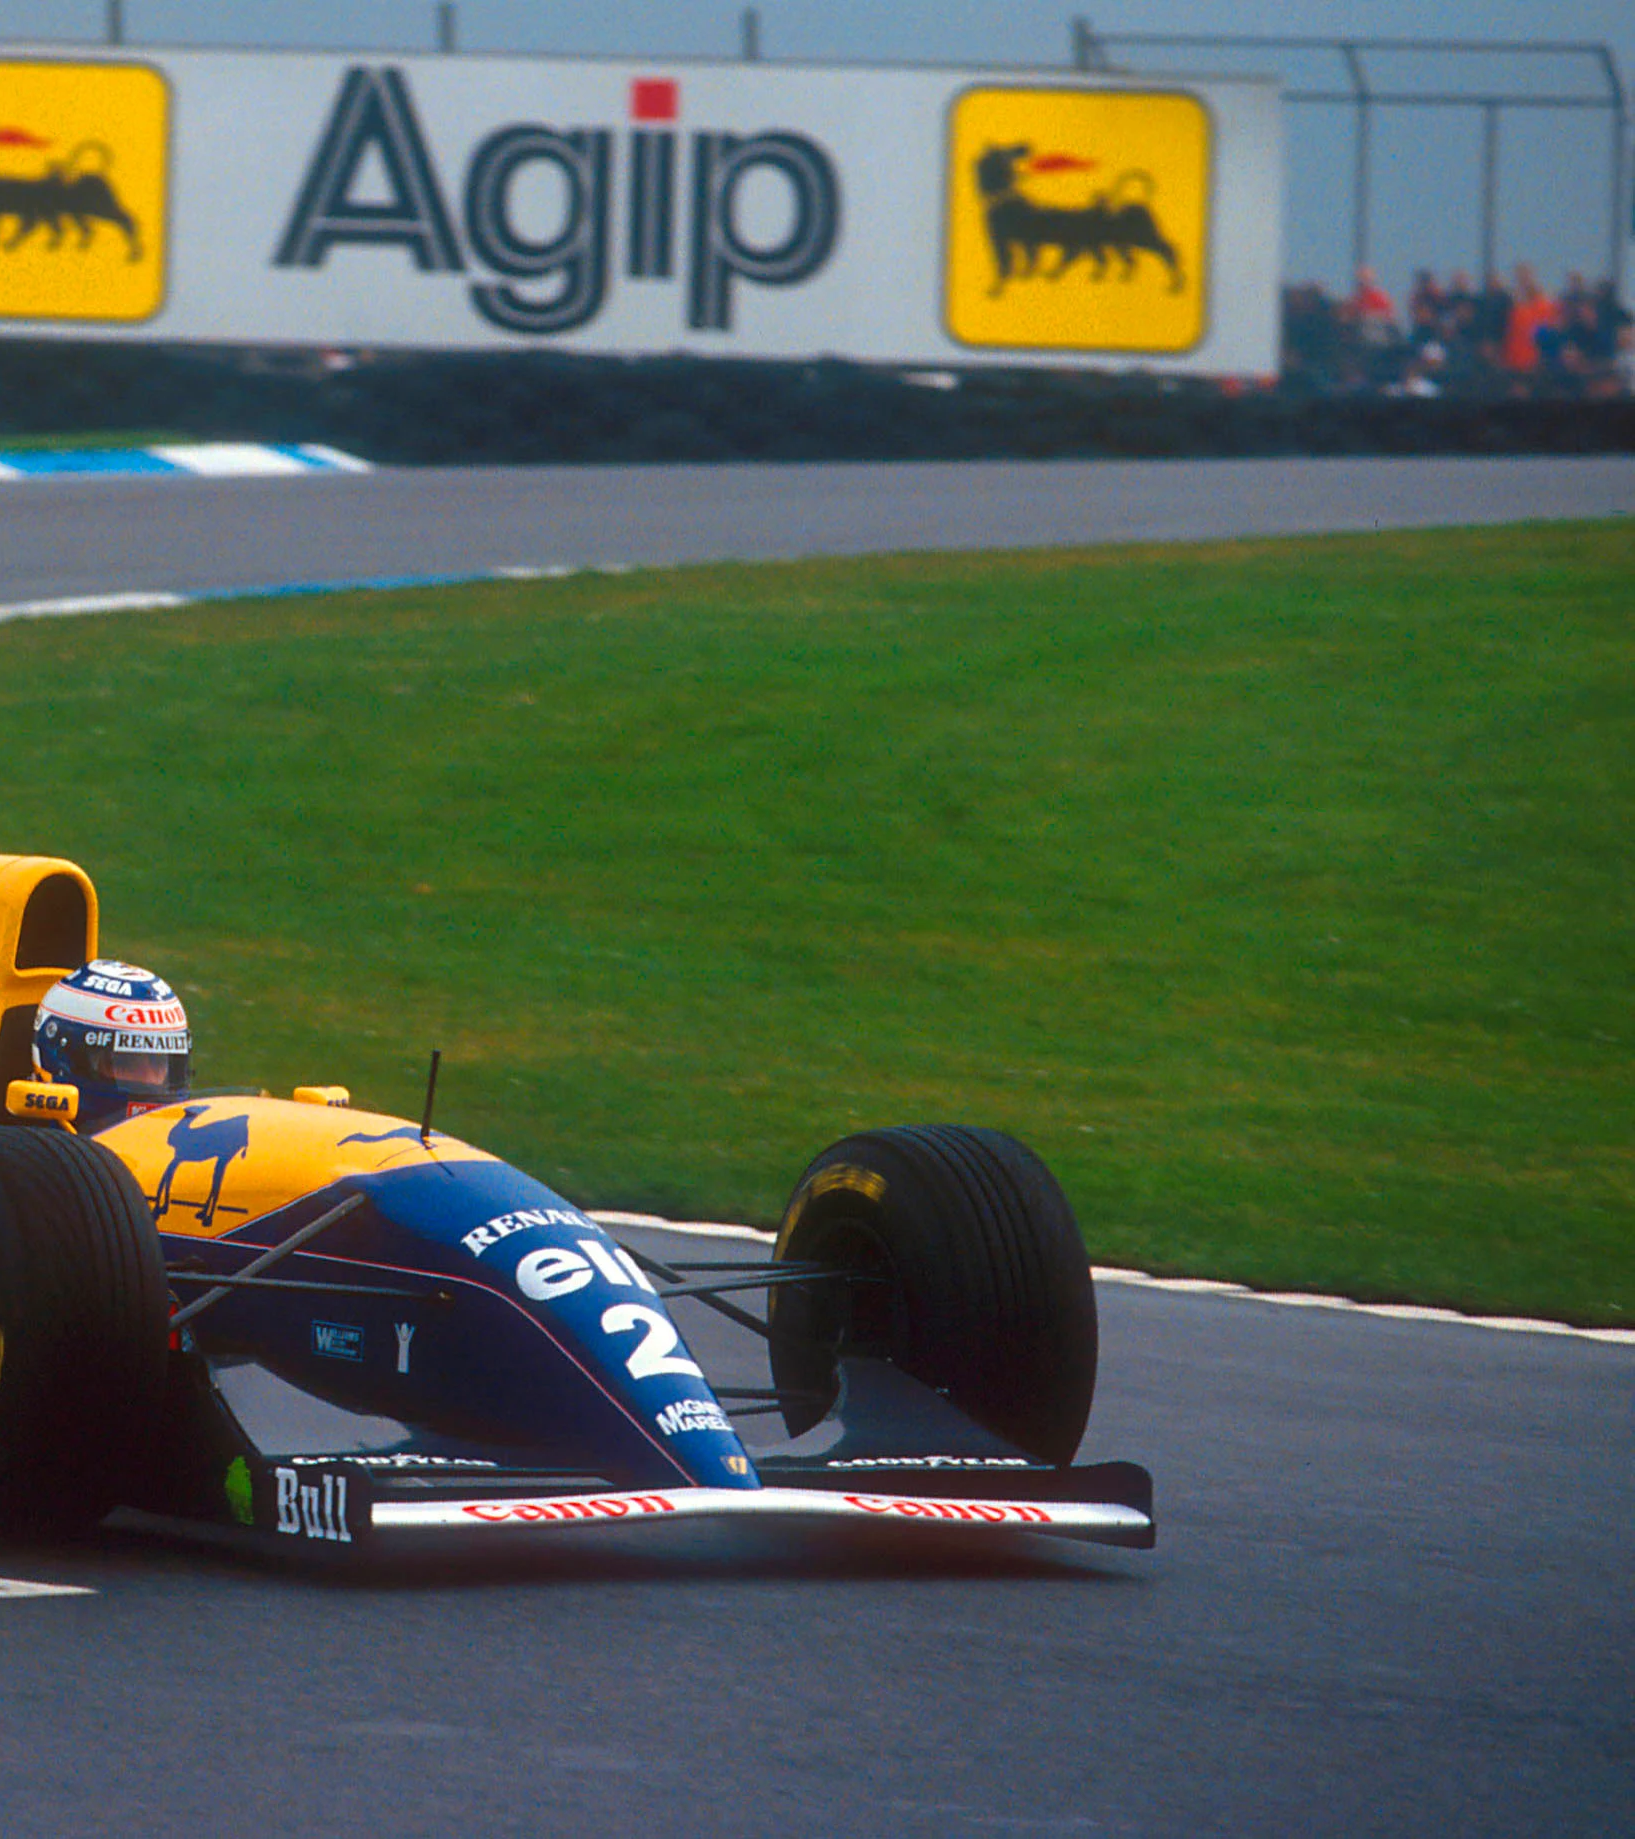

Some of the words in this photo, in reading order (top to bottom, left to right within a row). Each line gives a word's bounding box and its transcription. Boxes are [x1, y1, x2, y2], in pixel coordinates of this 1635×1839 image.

[270, 65, 842, 335] Agip
[83, 974, 132, 997] SEGA
[85, 1031, 112, 1047] elf
[118, 1034, 187, 1051] RENAULT
[24, 1093, 70, 1112] SEGA
[601, 1303, 704, 1380] 2
[275, 1467, 352, 1542] Bull
[462, 1495, 676, 1522] Canon
[843, 1495, 1053, 1522] Canon
